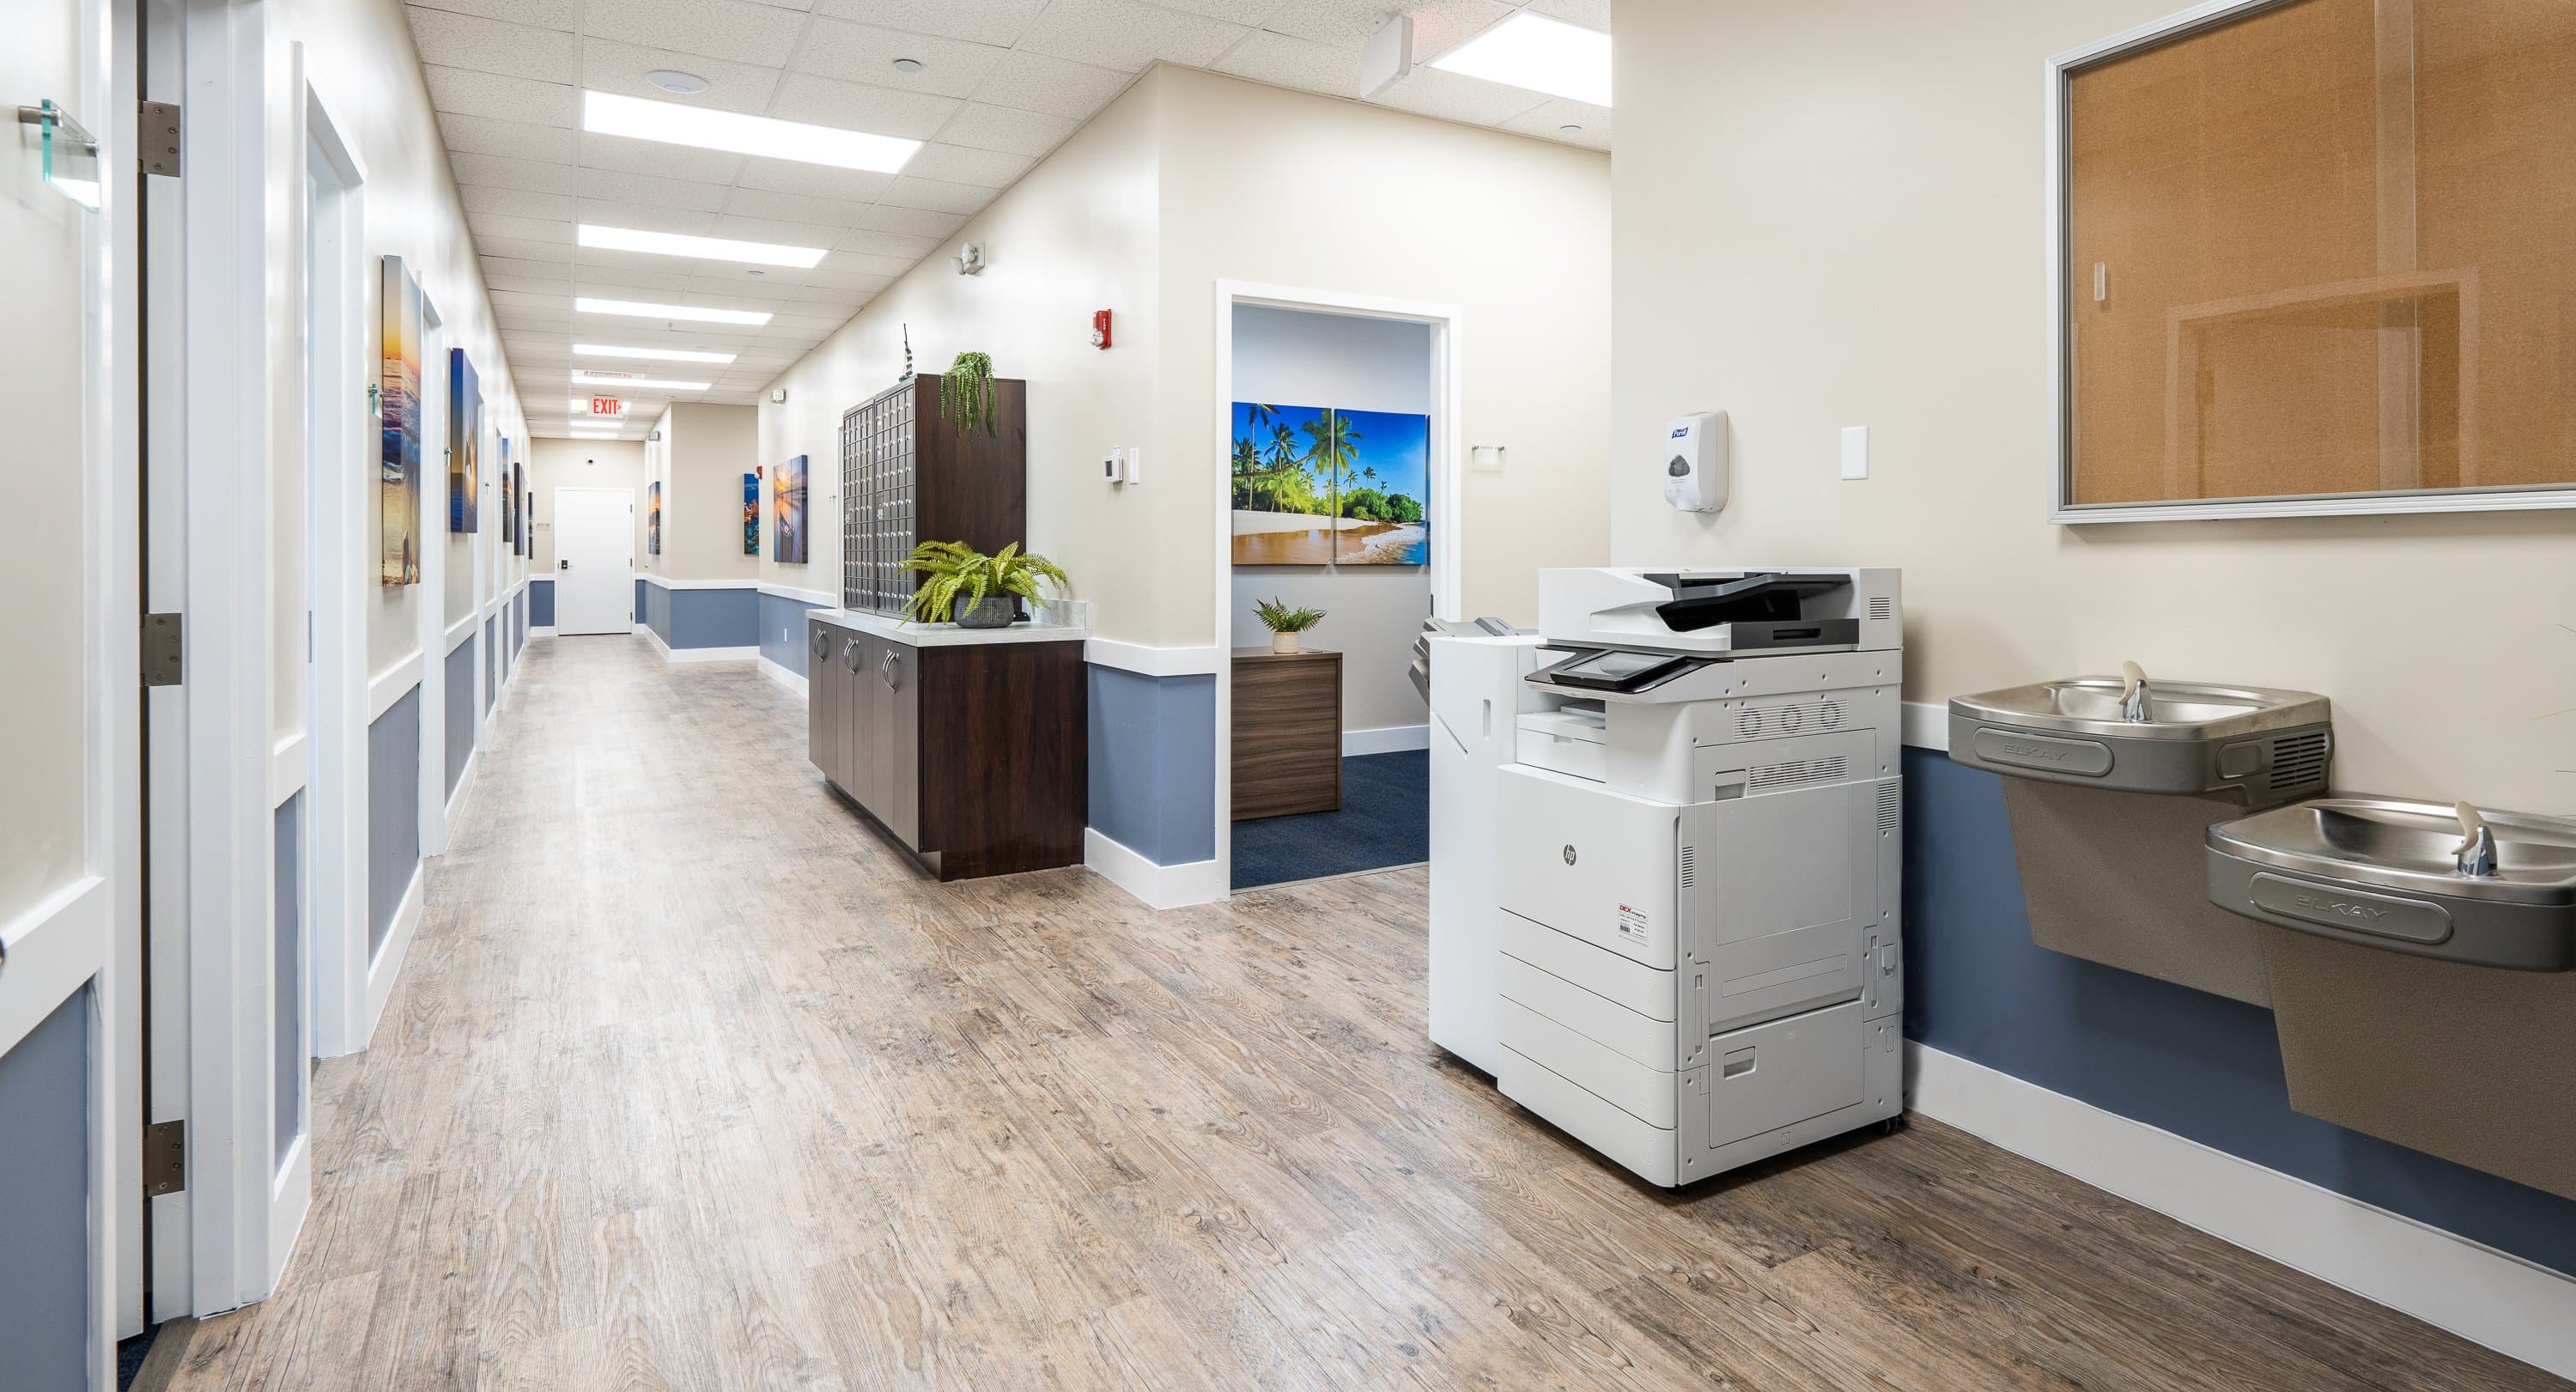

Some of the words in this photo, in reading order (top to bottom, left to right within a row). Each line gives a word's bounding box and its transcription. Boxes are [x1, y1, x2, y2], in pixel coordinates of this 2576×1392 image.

[593, 398, 618, 415] EXIT
[2002, 743, 2069, 761] ELKAY
[1619, 904, 1631, 914] DEX
[2294, 893, 2389, 920] ELKAY
